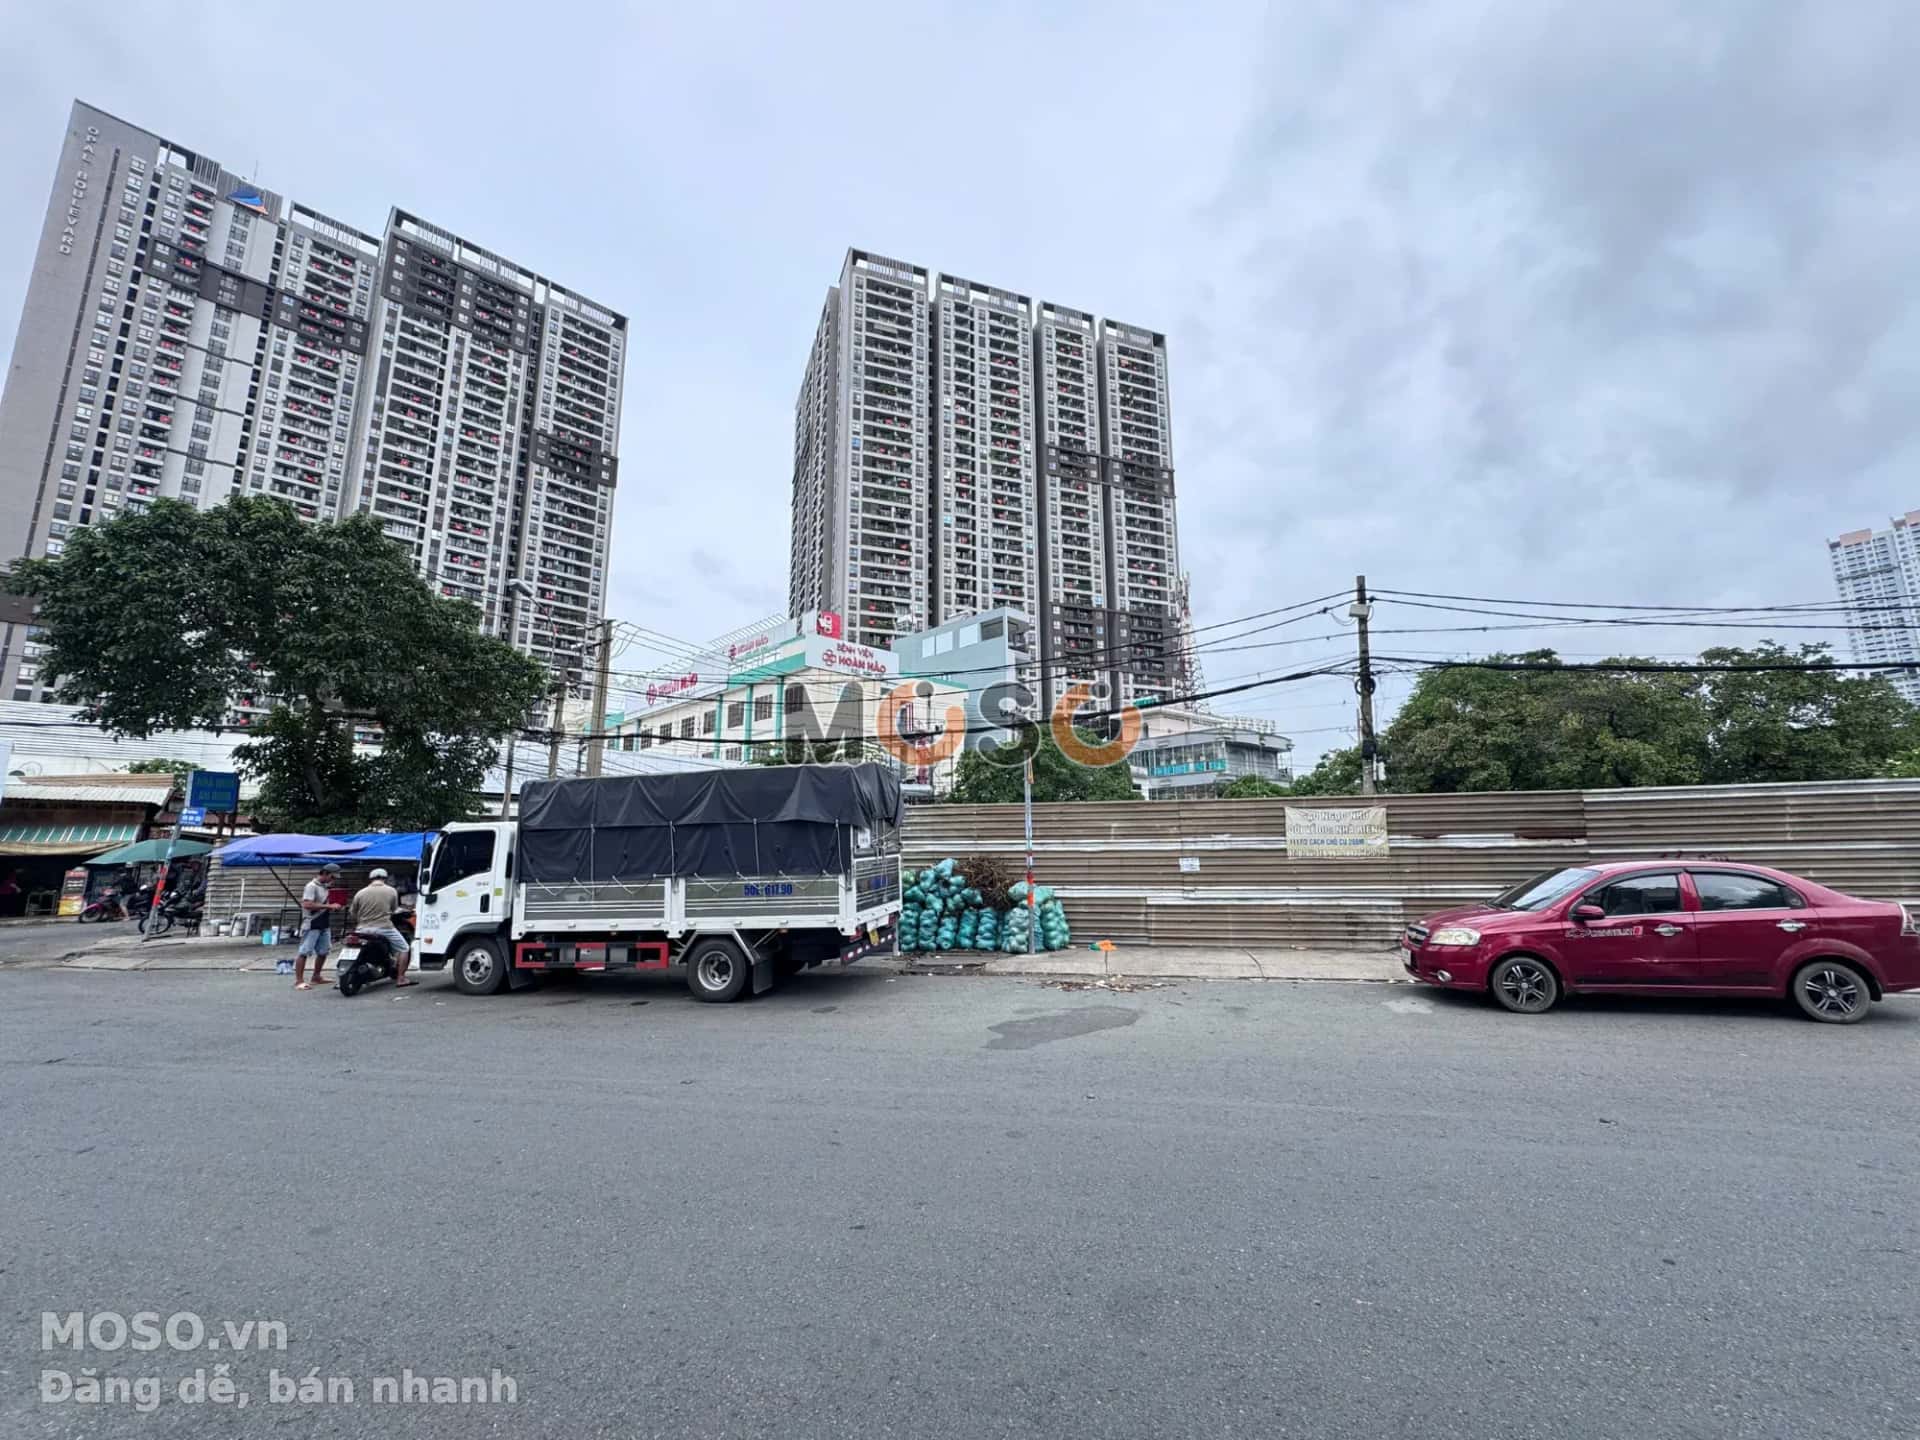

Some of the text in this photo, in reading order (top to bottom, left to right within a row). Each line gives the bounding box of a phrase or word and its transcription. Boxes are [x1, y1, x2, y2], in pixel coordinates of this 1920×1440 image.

[59, 125, 99, 255] OPAL BOULEVARD
[838, 656, 866, 670] HOÀN
